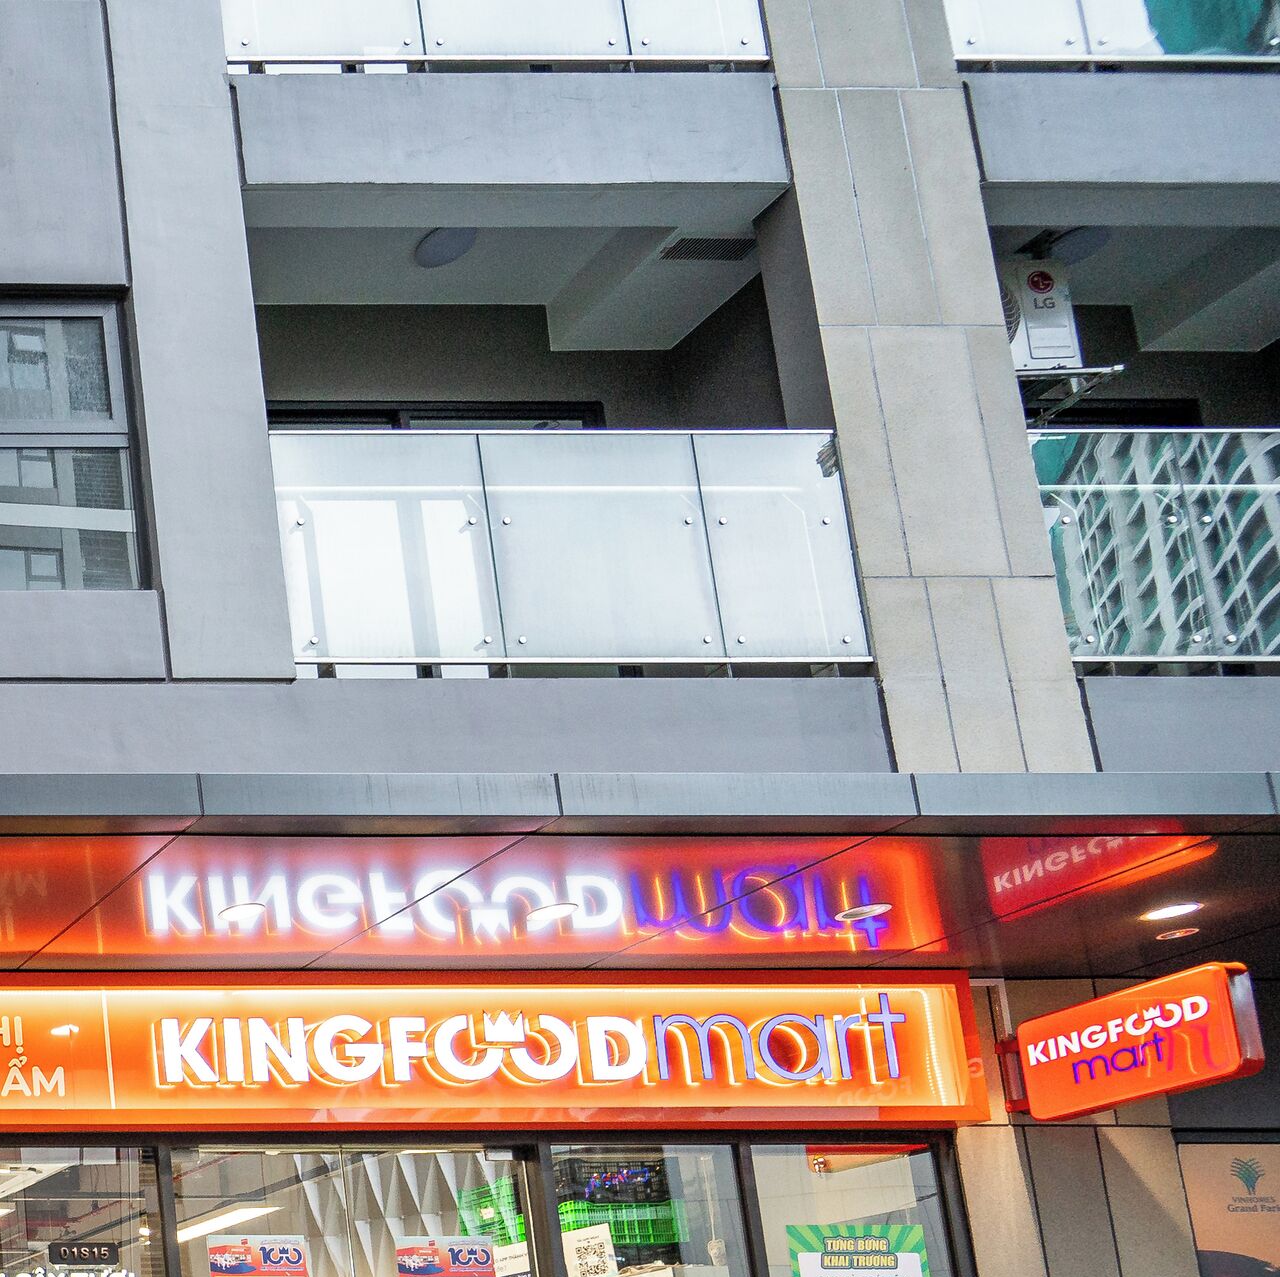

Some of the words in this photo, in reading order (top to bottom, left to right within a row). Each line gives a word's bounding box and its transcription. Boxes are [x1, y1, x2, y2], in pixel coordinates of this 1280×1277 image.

[1033, 297, 1056, 310] LG
[1027, 995, 1210, 1067] KINGFOOD
[1072, 1032, 1165, 1085] mart
[1227, 1204, 1258, 1212] Grand
[827, 1239, 854, 1252] TƯNG
[857, 1238, 887, 1252] BỪNG
[60, 1247, 109, 1260] 01S15
[824, 1255, 849, 1267] KHAI
[852, 1254, 895, 1267] TRƯƠNG
